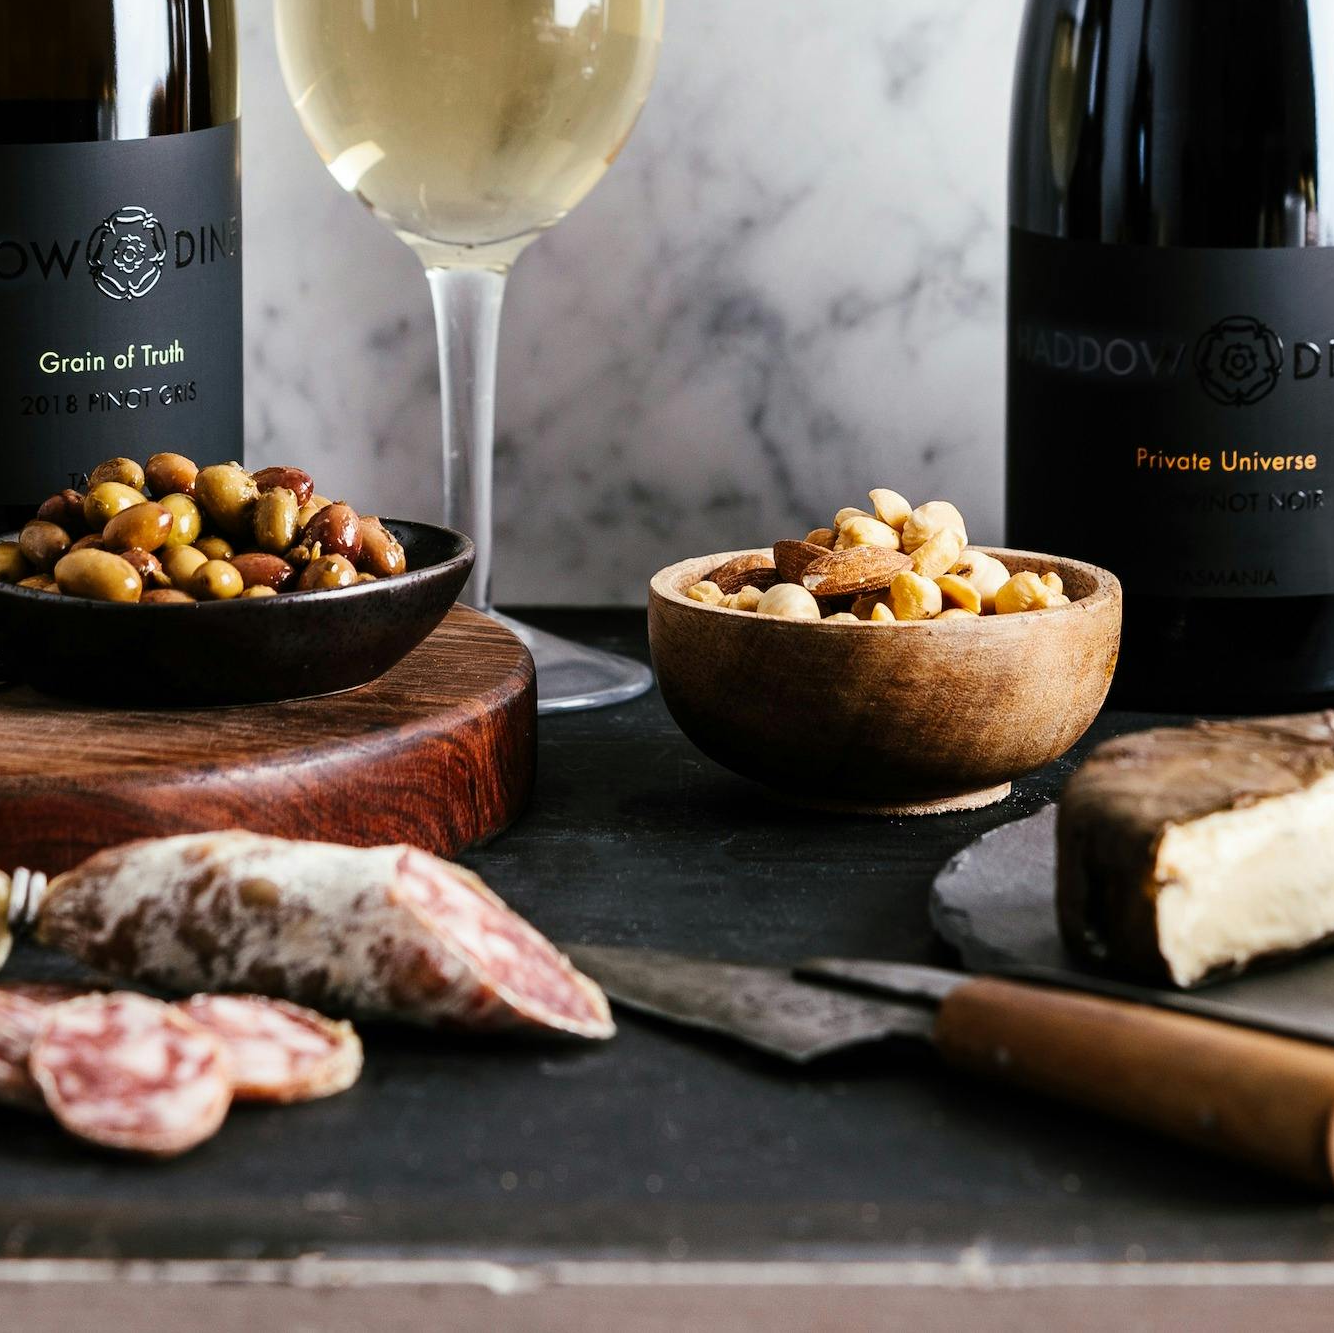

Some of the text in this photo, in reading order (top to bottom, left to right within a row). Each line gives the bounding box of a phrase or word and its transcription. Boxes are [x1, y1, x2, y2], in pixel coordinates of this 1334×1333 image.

[39, 339, 185, 374] Grain of Truth
[20, 380, 198, 417] 2018 PINOT GRIS
[1136, 447, 1318, 473] Private Universe
[1268, 489, 1324, 513] NOIR
